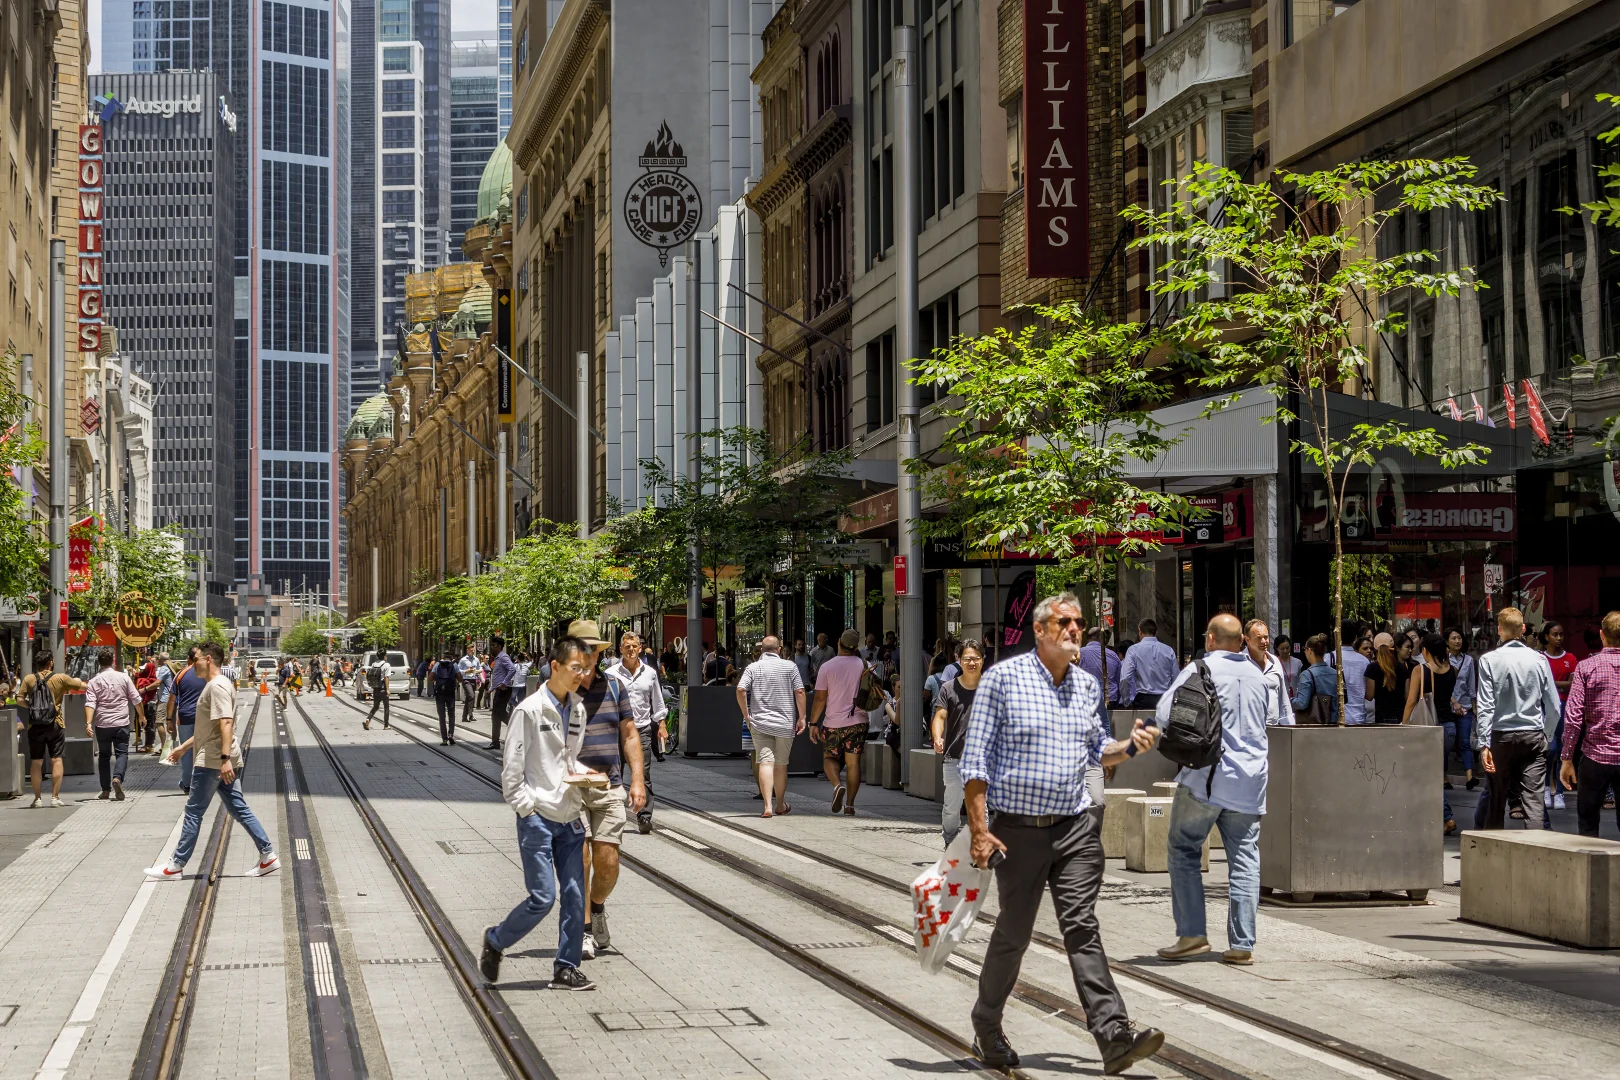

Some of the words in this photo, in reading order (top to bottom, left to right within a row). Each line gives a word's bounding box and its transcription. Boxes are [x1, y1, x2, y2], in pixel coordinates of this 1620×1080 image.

[124, 95, 201, 118] Ausgrid
[638, 174, 688, 192] HEALTH
[645, 195, 681, 223] HCF
[80, 127, 100, 350] GOWINGS
[628, 209, 654, 242] CARE
[673, 209, 698, 242] FUND
